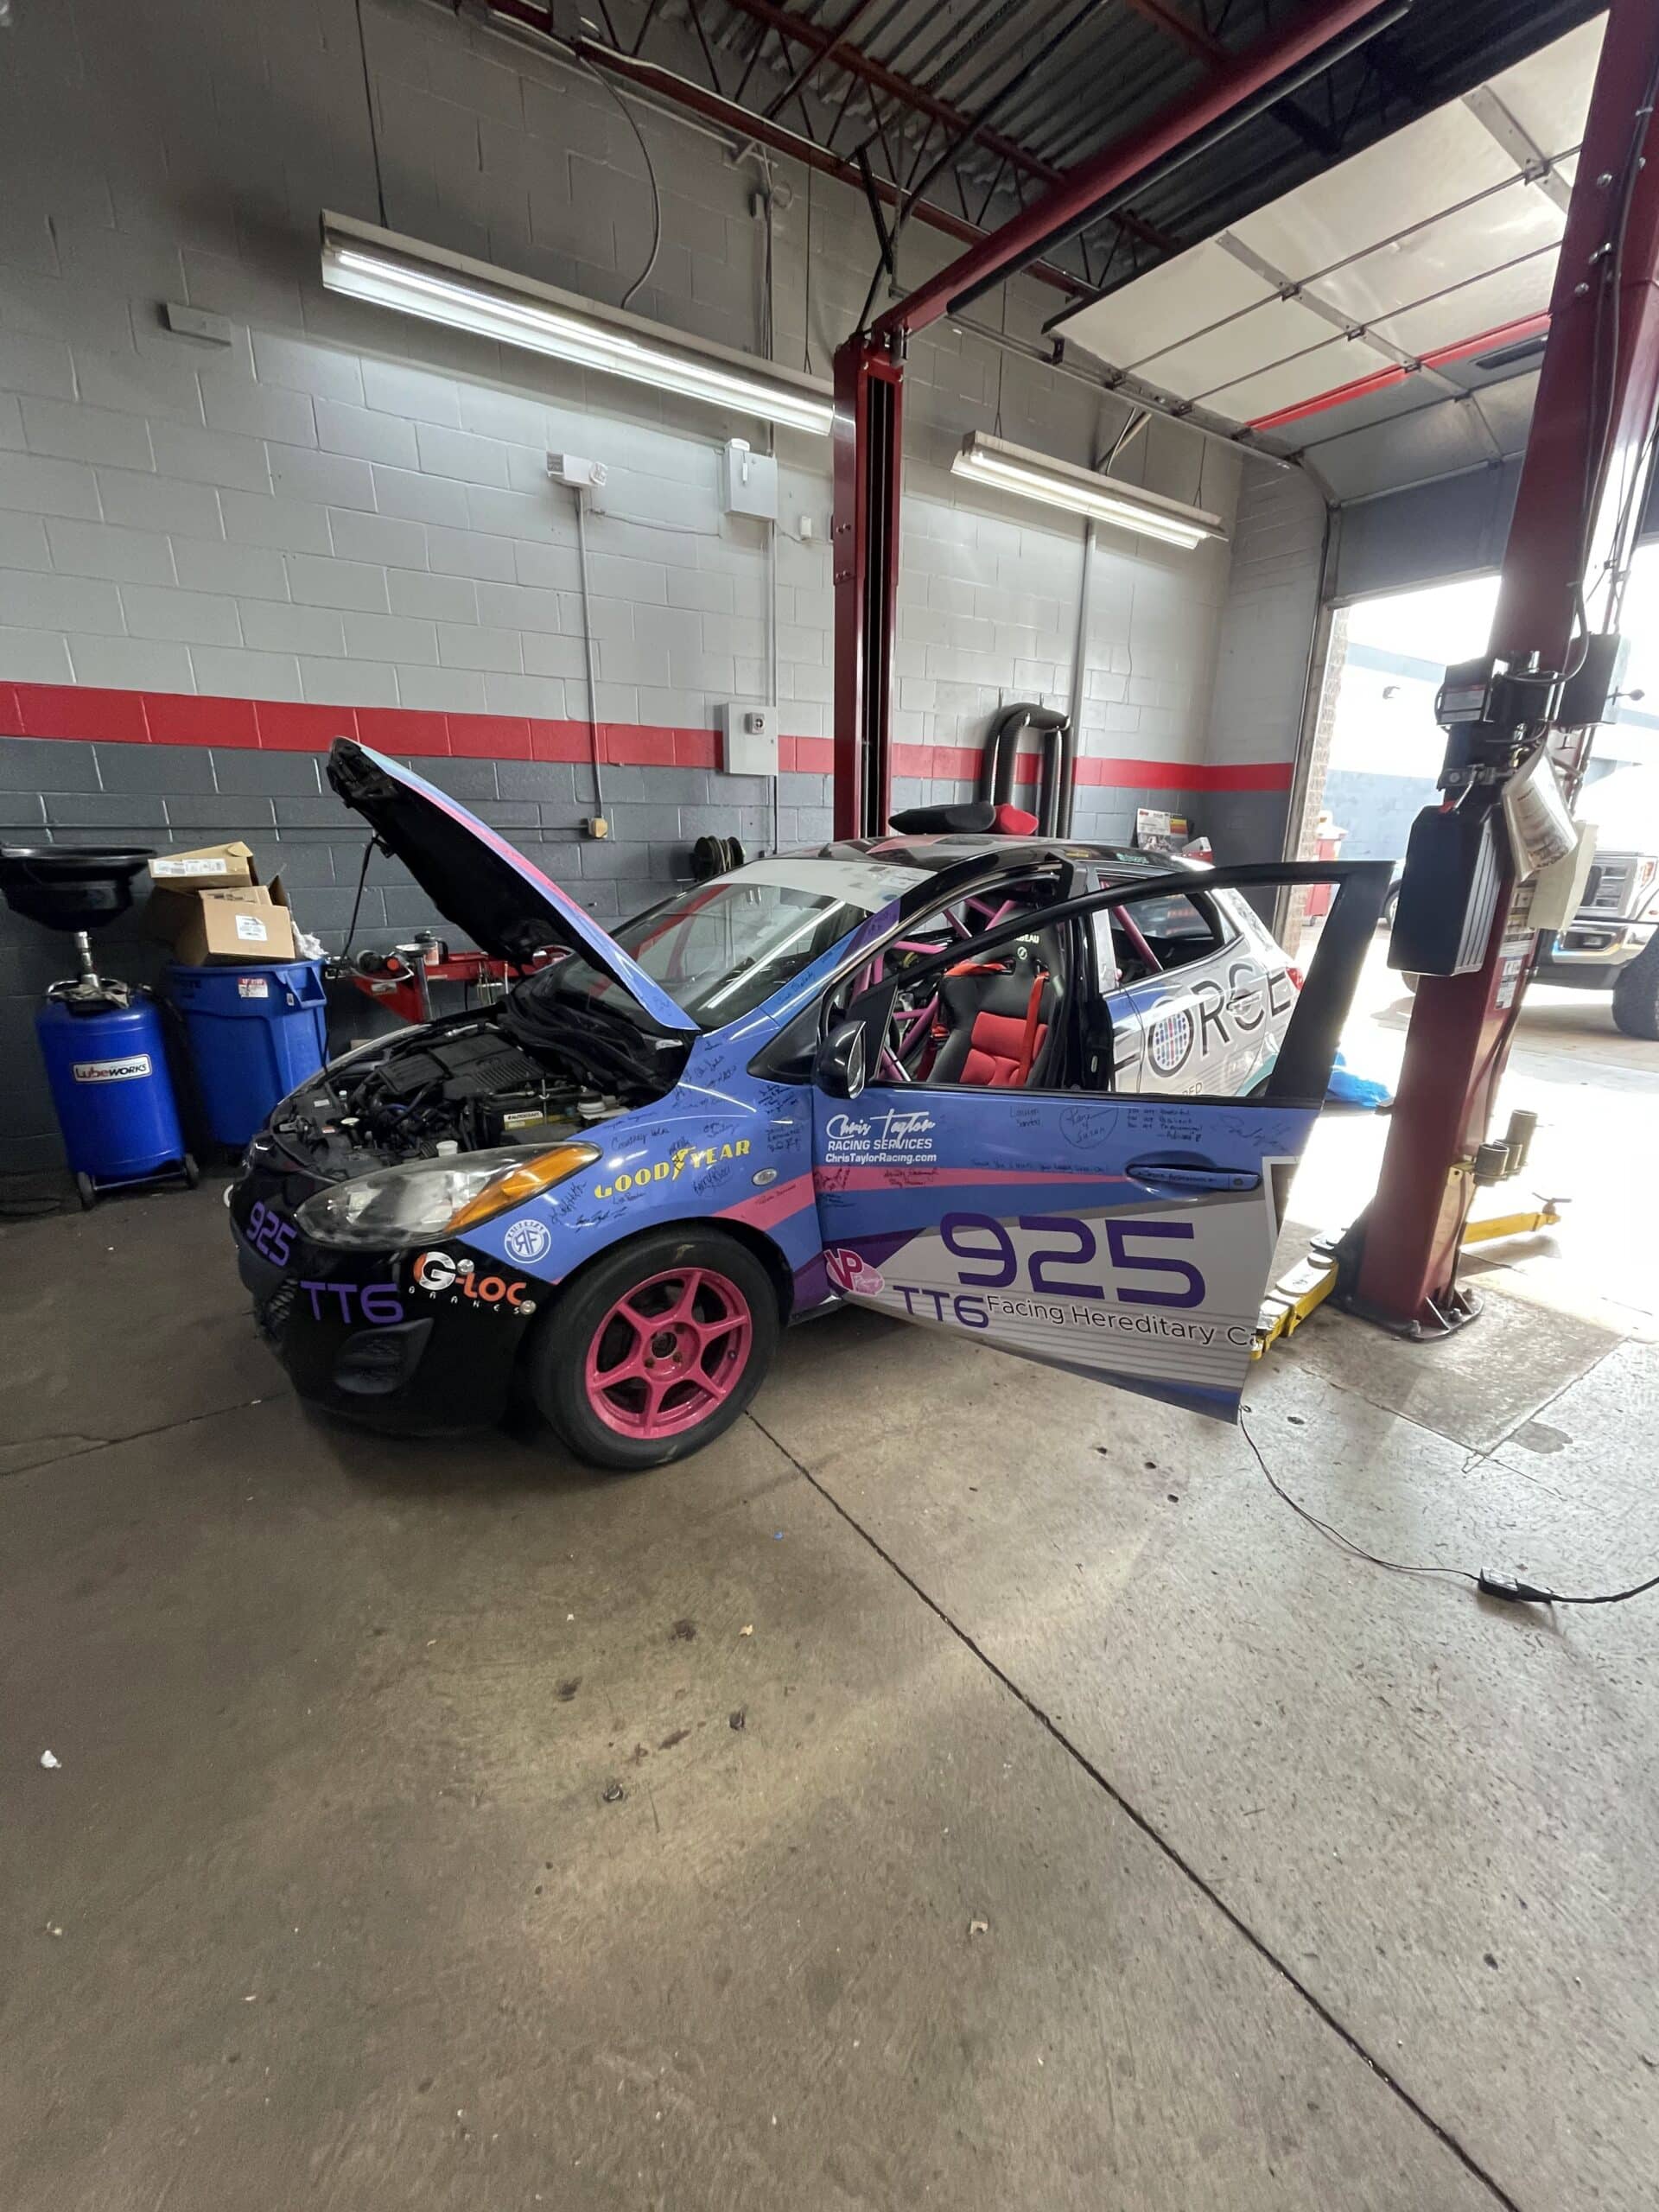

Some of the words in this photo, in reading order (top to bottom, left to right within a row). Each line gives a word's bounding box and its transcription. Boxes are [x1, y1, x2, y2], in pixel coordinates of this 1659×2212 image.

[826, 1114, 871, 1140] Chris
[869, 1108, 936, 1148] Taylor
[828, 1140, 870, 1151] RACING
[874, 1138, 932, 1149] SERVICES
[825, 1152, 937, 1164] ChrisTaylorRacing.com
[246, 1201, 298, 1267] 925
[413, 1251, 527, 1306] G-LOC
[824, 1249, 863, 1292] VP
[939, 1211, 1206, 1308] 925
[301, 1281, 404, 1324] TT6
[893, 1285, 990, 1328] TT6
[986, 1295, 1065, 1325] Facing
[1071, 1306, 1215, 1345] Hereditary
